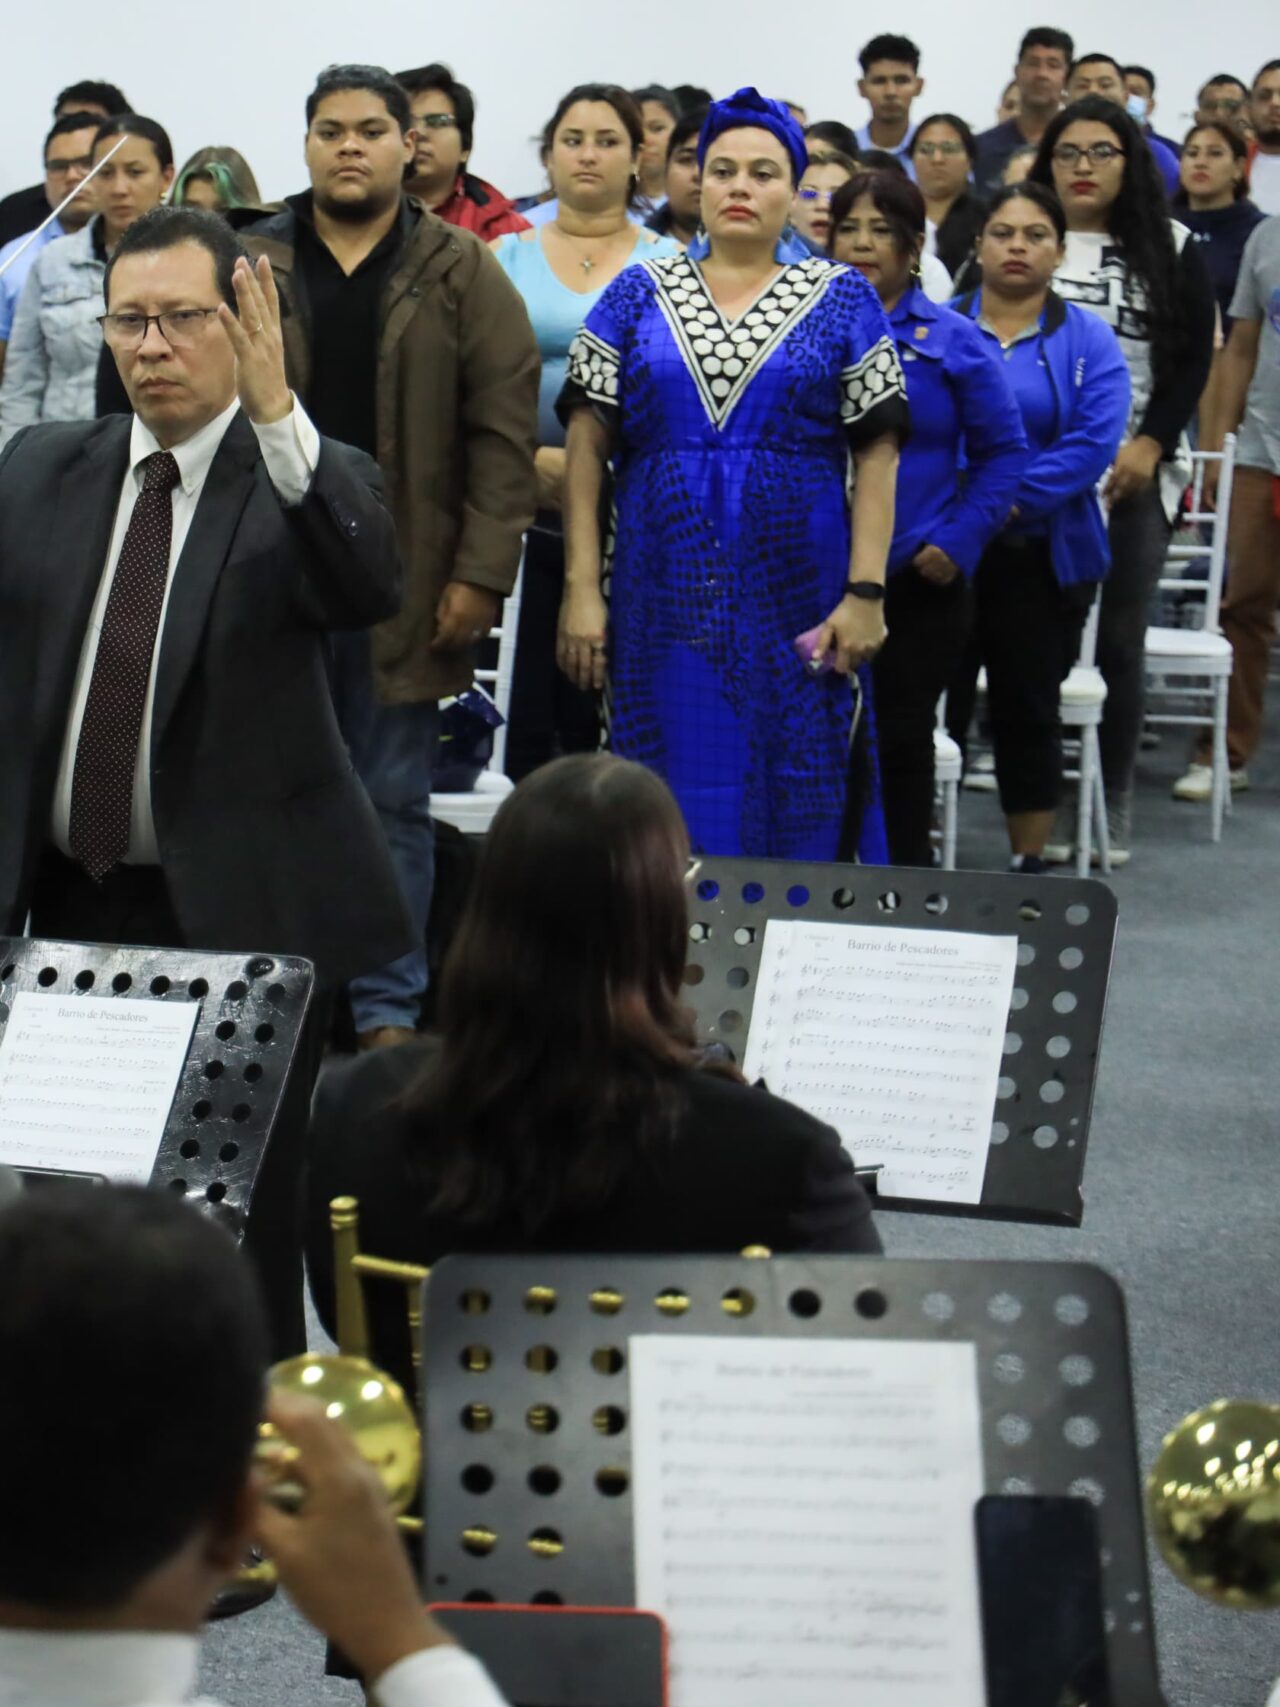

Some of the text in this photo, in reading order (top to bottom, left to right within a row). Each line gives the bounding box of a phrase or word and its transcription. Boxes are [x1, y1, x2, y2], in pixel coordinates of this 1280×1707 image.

[847, 938, 882, 953] Barrio
[883, 940, 897, 953] de
[899, 942, 959, 957] Pescadores
[57, 1007, 86, 1020] Barrio
[87, 1008, 98, 1020] de
[100, 1009, 149, 1023] Pescadores
